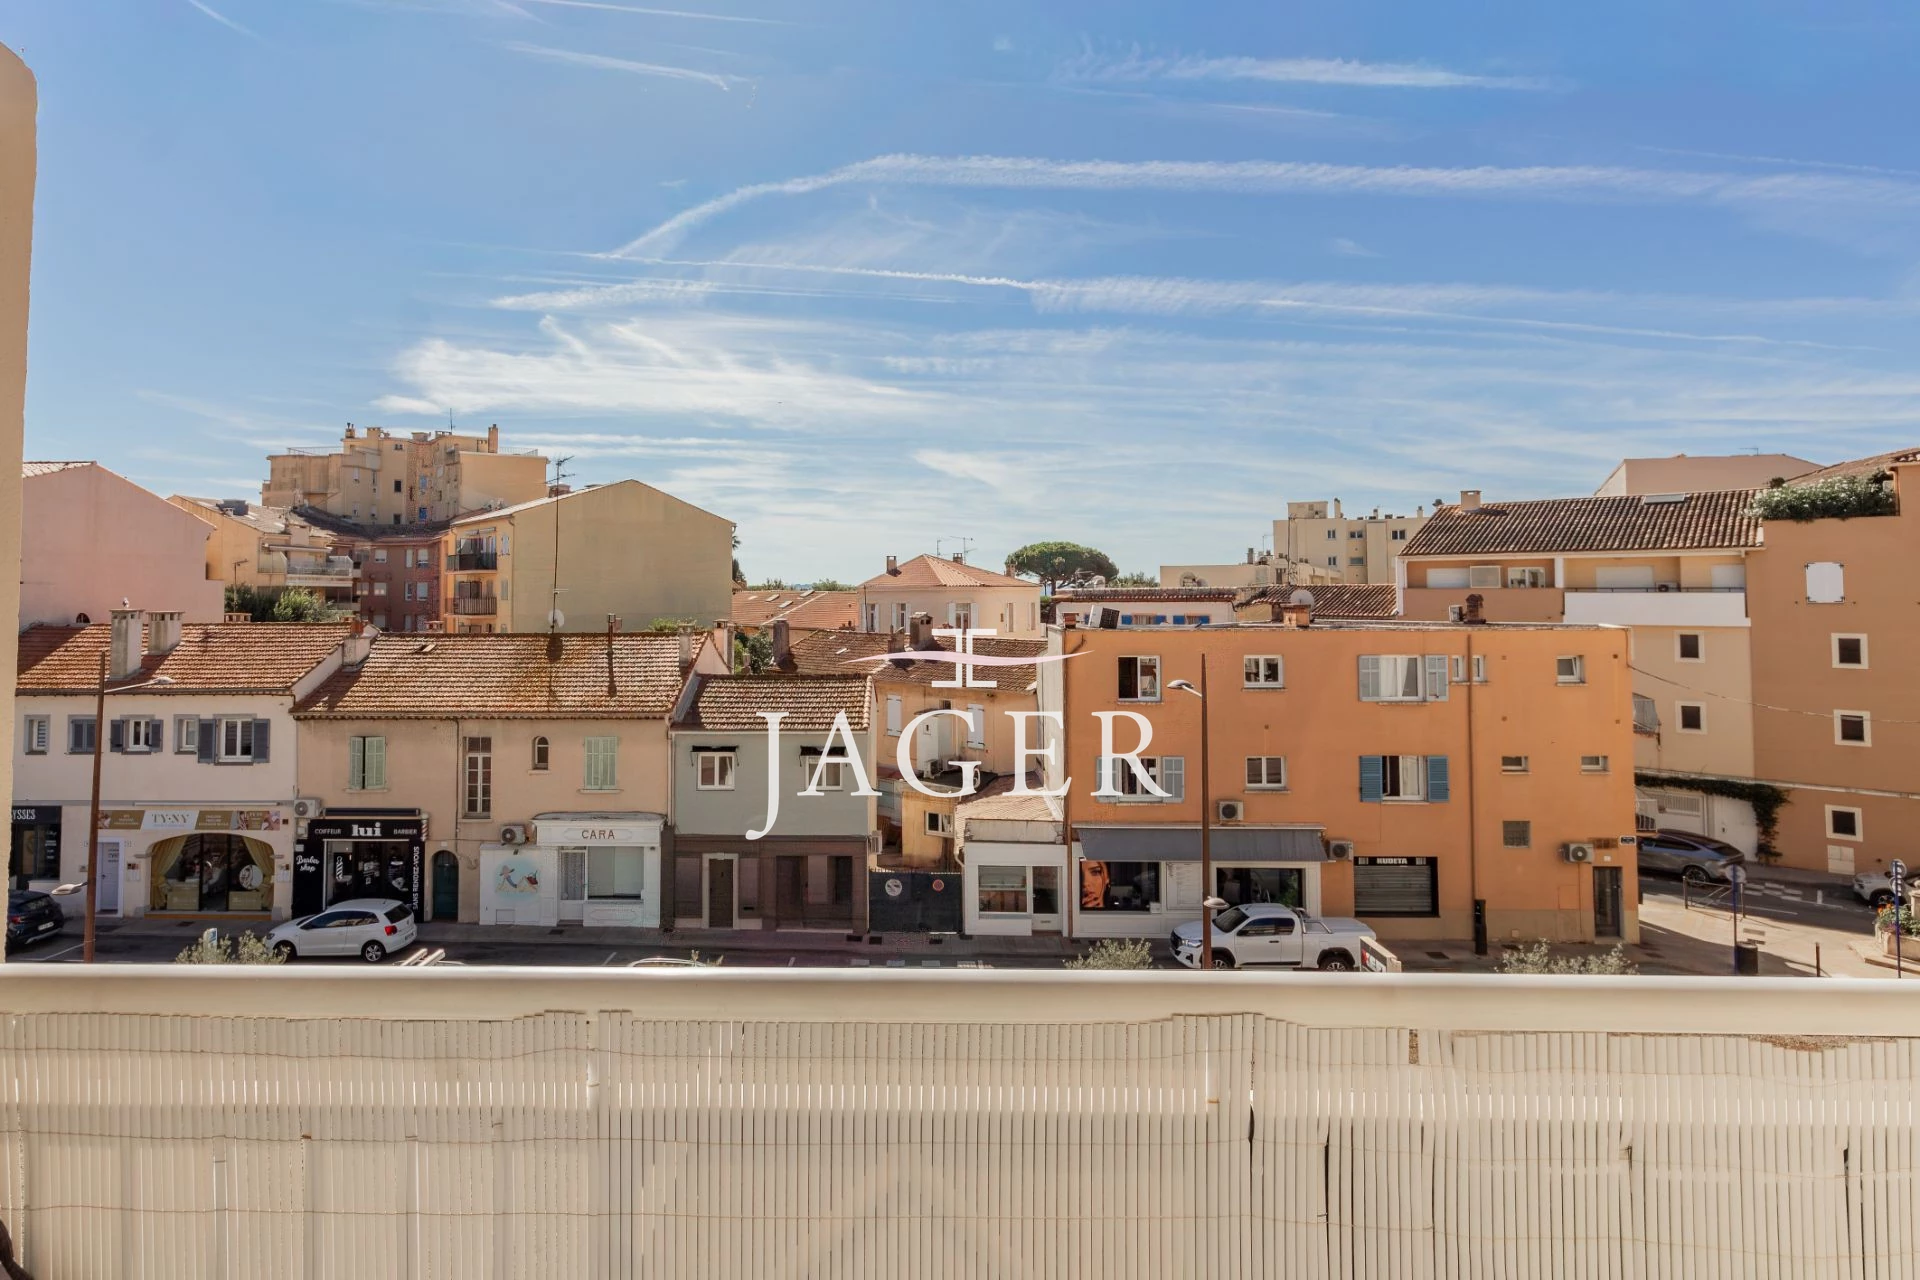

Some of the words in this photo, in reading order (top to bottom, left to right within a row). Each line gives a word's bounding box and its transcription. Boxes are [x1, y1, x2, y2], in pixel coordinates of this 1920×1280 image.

[351, 822, 382, 837] lui
[581, 829, 615, 840] CARA
[295, 855, 320, 865] Barber
